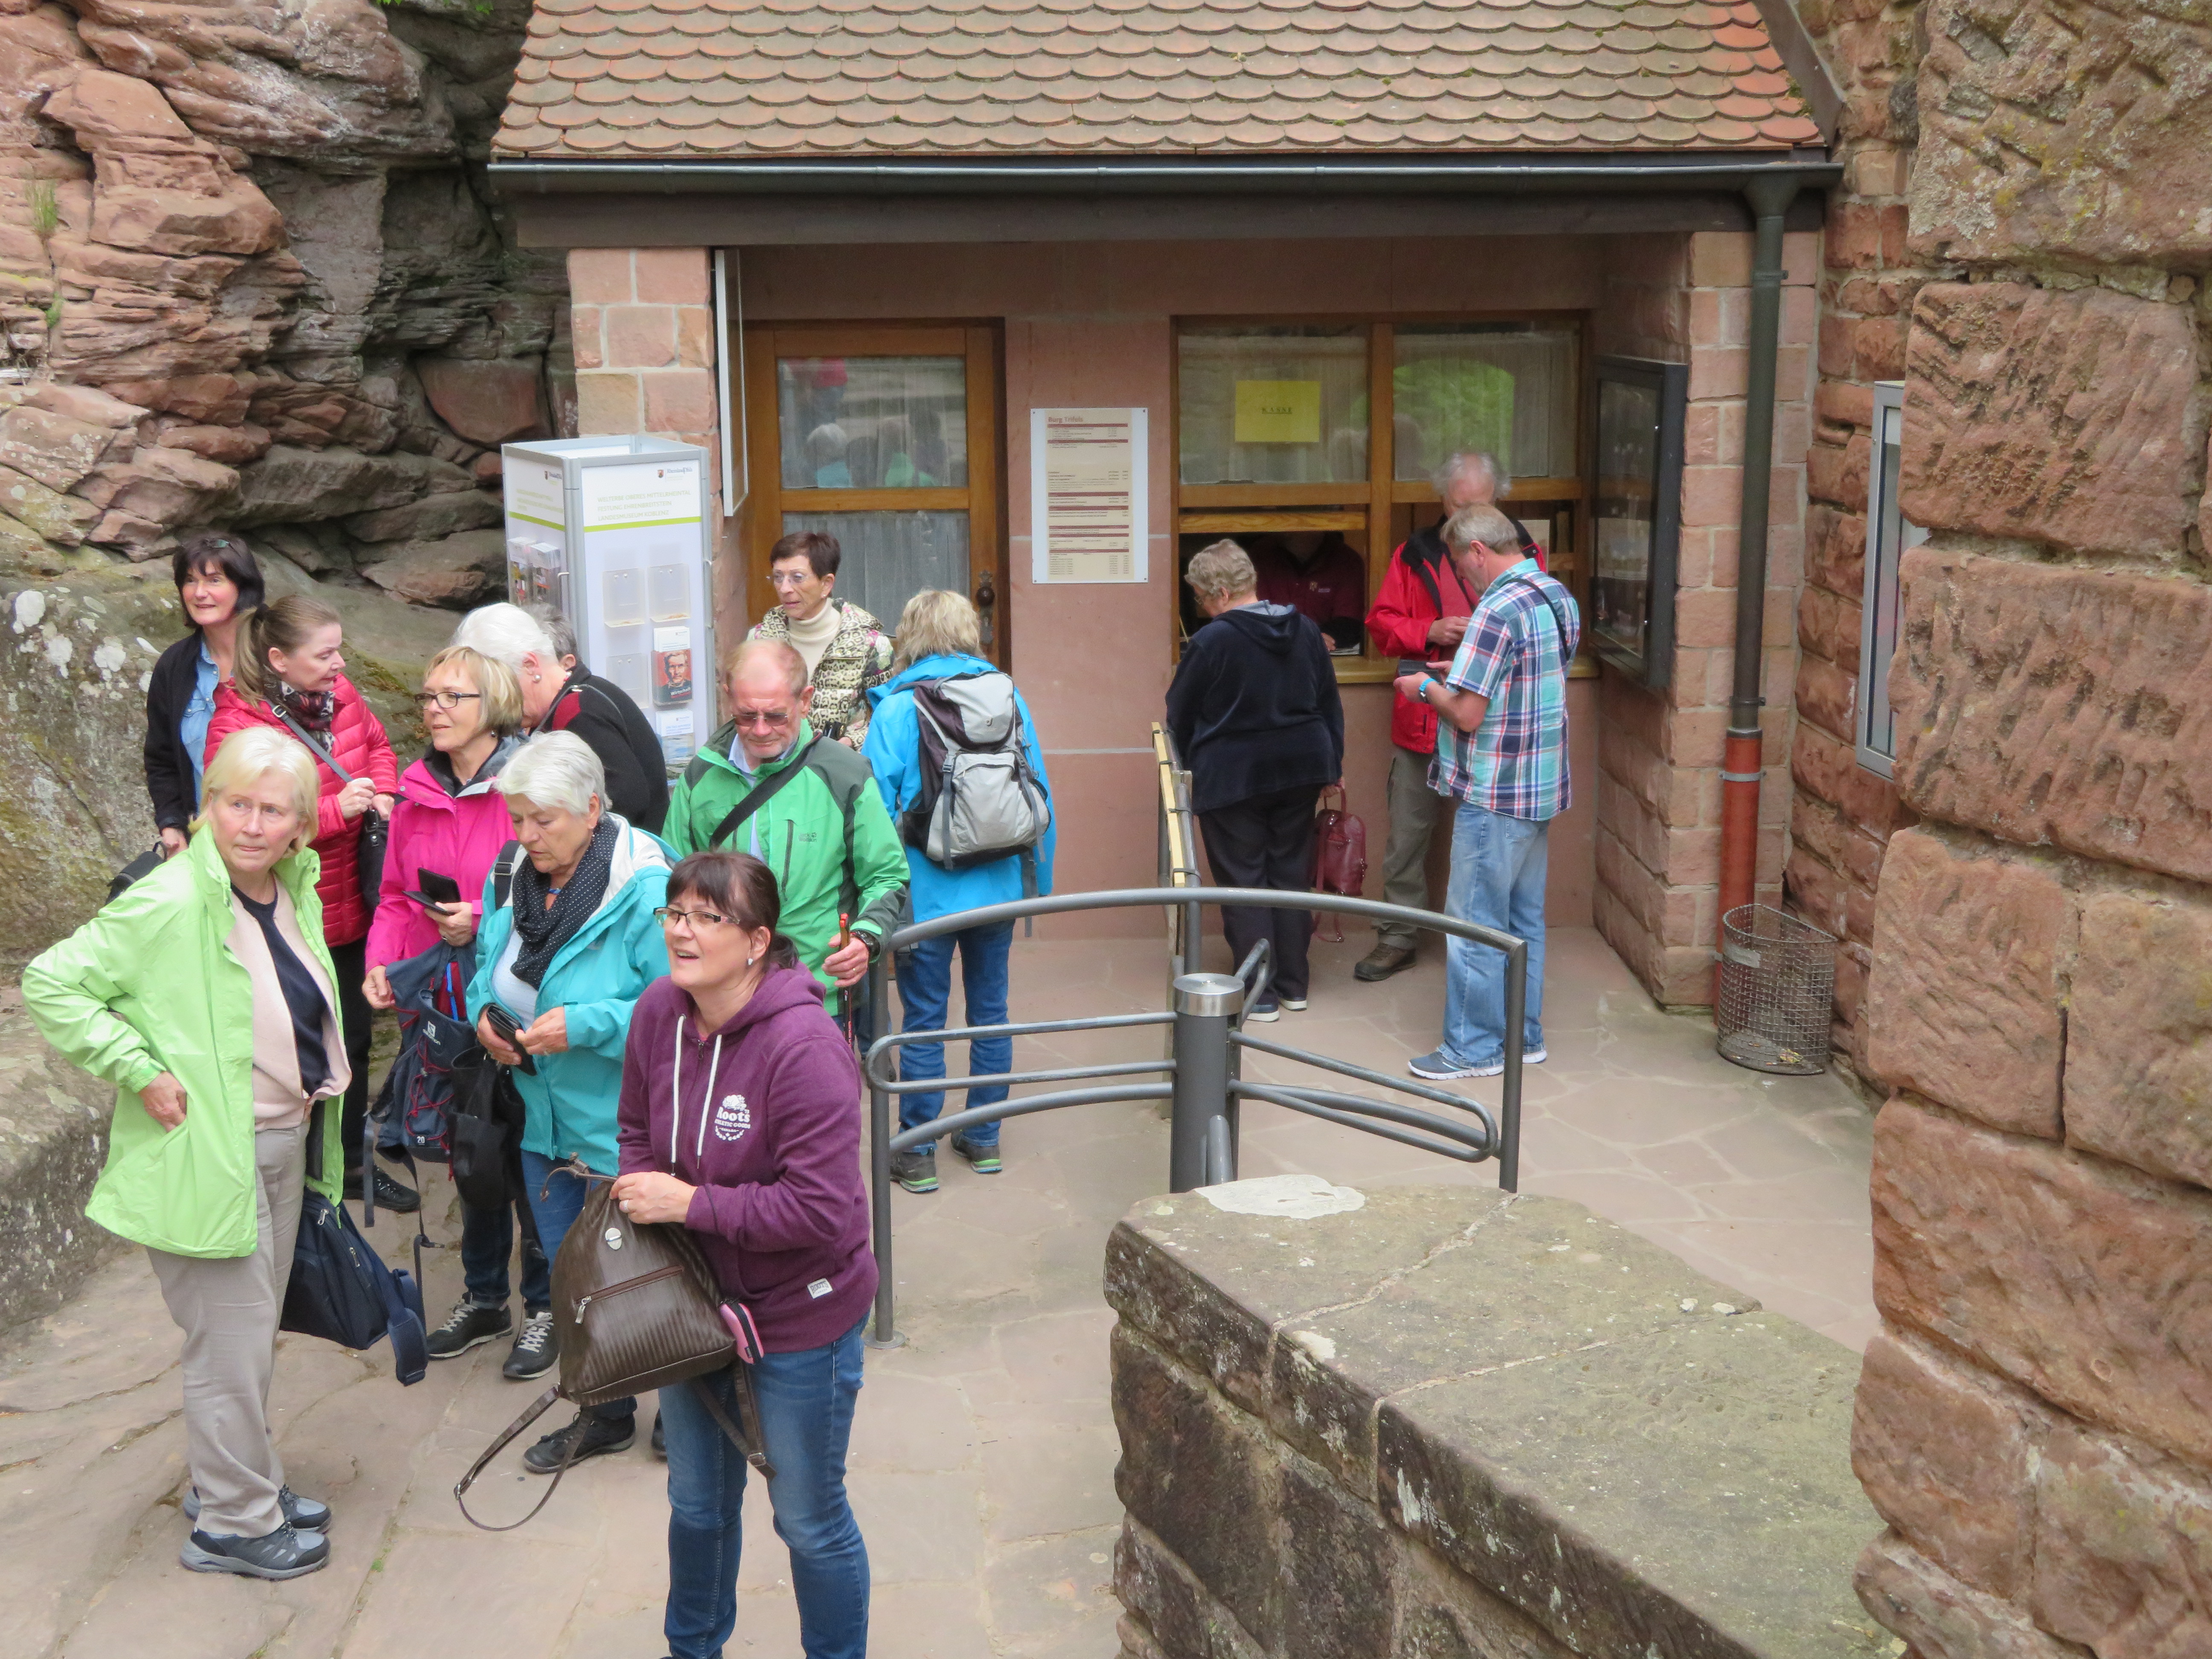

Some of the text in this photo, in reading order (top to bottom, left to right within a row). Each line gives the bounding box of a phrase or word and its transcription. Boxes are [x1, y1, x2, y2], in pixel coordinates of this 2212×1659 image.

[646, 490, 691, 498] MITTELRHEINTAL
[624, 501, 672, 509] EHRENBREITSTEIN
[598, 513, 643, 521] LANDESMUSEUM
[670, 687, 691, 696] Wirtschaft
[716, 1106, 751, 1123] Roots
[810, 1281, 829, 1295] ROOTS
